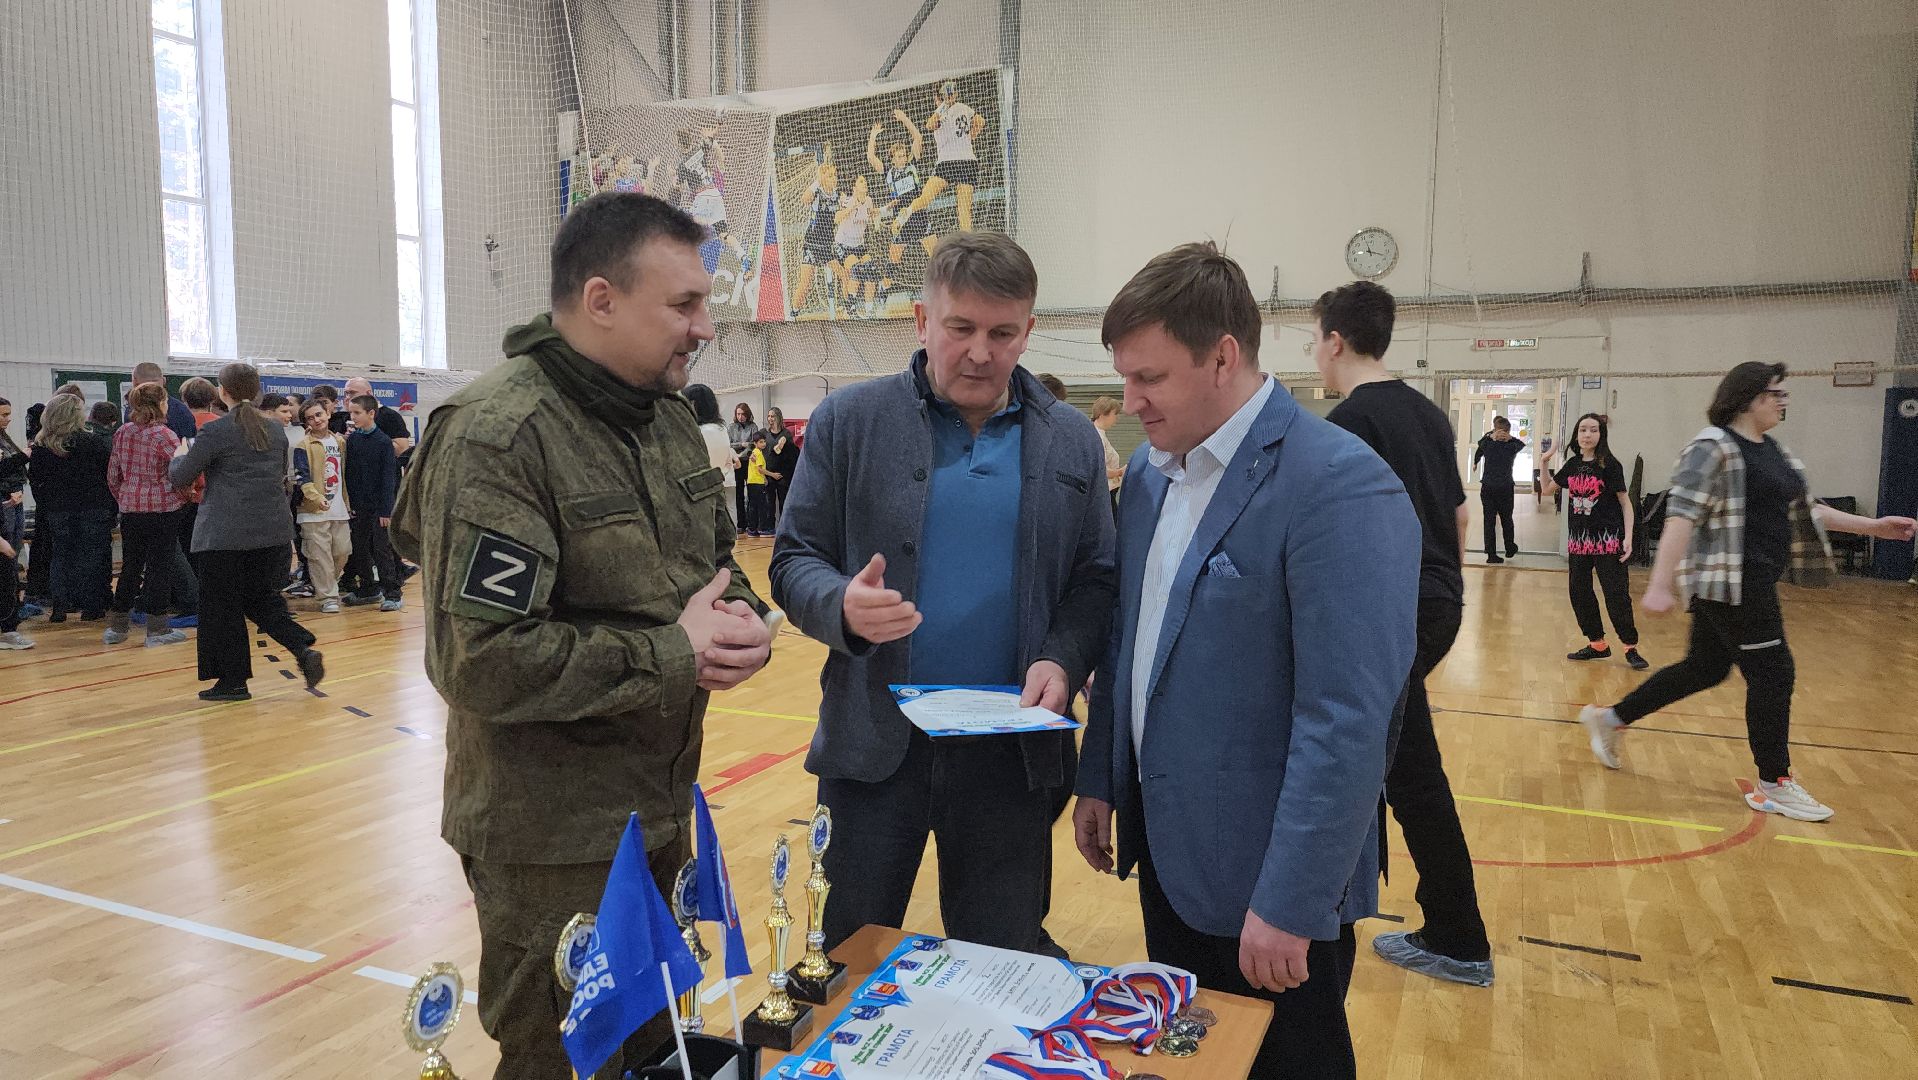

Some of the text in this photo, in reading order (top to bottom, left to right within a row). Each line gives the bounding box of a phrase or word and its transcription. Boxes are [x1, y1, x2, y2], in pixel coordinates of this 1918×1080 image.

[1509, 338, 1535, 347] ВЫХОД
[481, 550, 527, 597] Z
[934, 959, 969, 989] ГРАМОТА
[875, 1028, 915, 1068] ГРАМОТА
